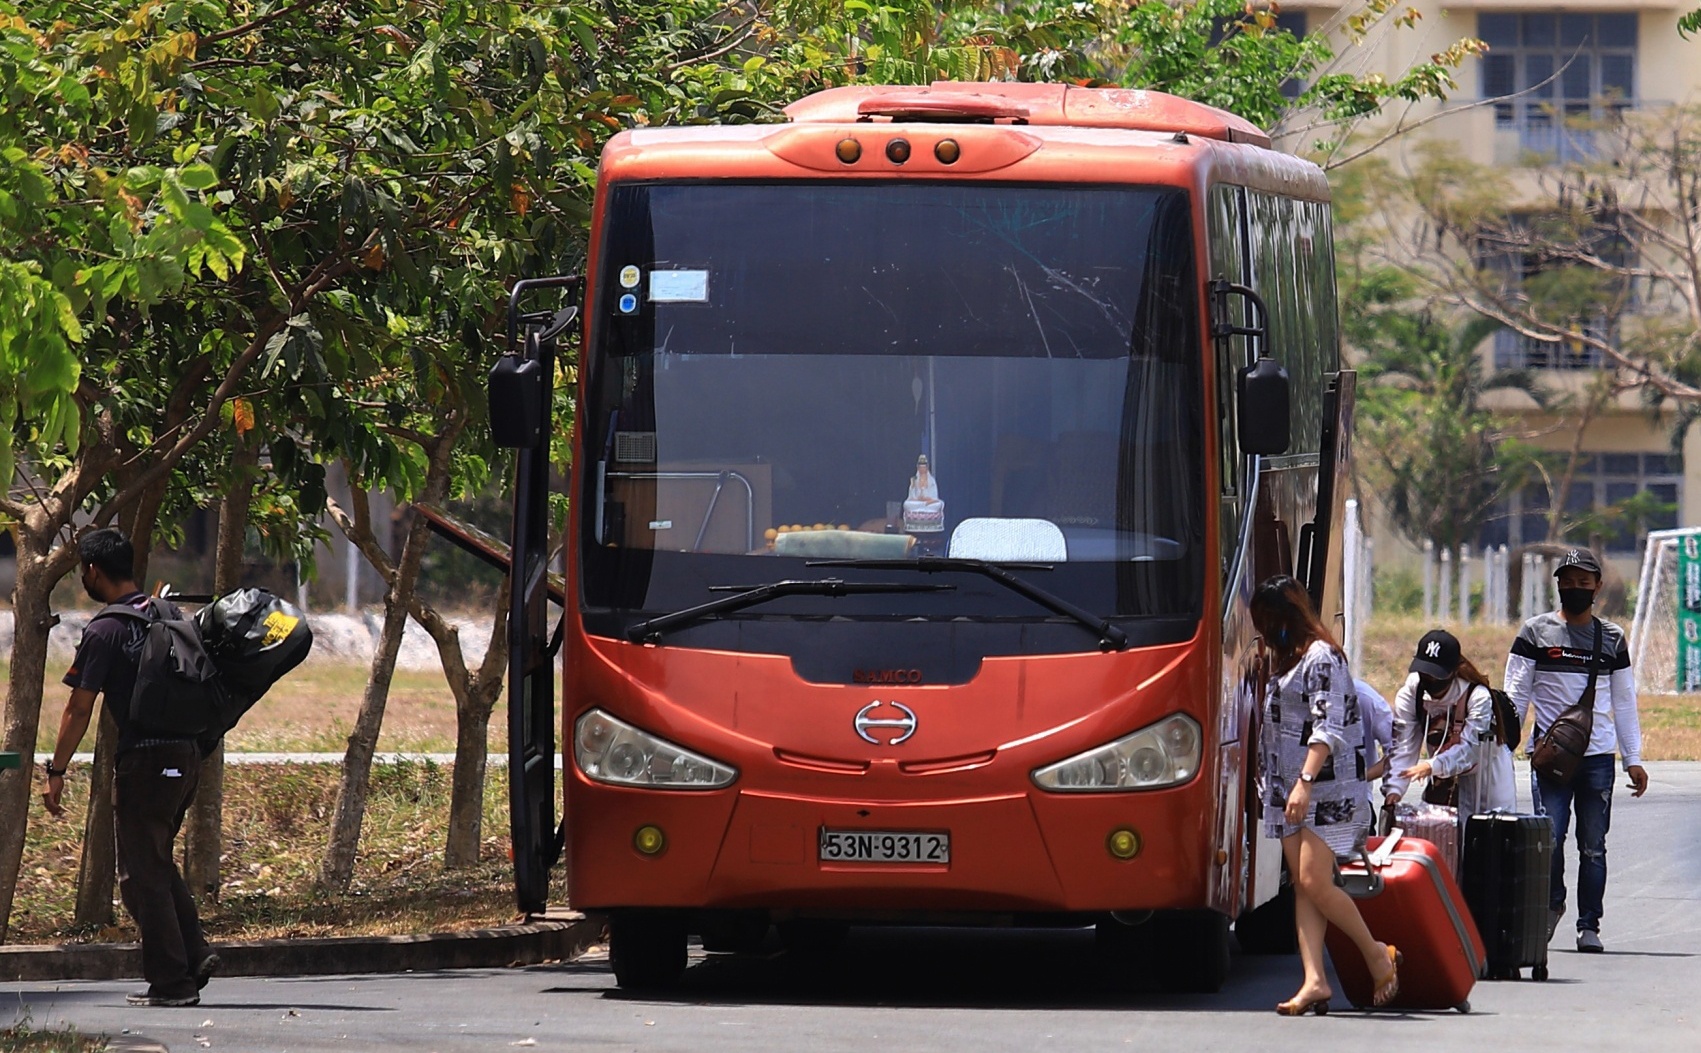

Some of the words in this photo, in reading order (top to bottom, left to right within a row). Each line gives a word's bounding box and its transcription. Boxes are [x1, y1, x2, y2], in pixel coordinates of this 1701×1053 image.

[1425, 640, 1441, 658] NY
[853, 669, 922, 684] SAMCO
[827, 834, 942, 860] 53N-9312
